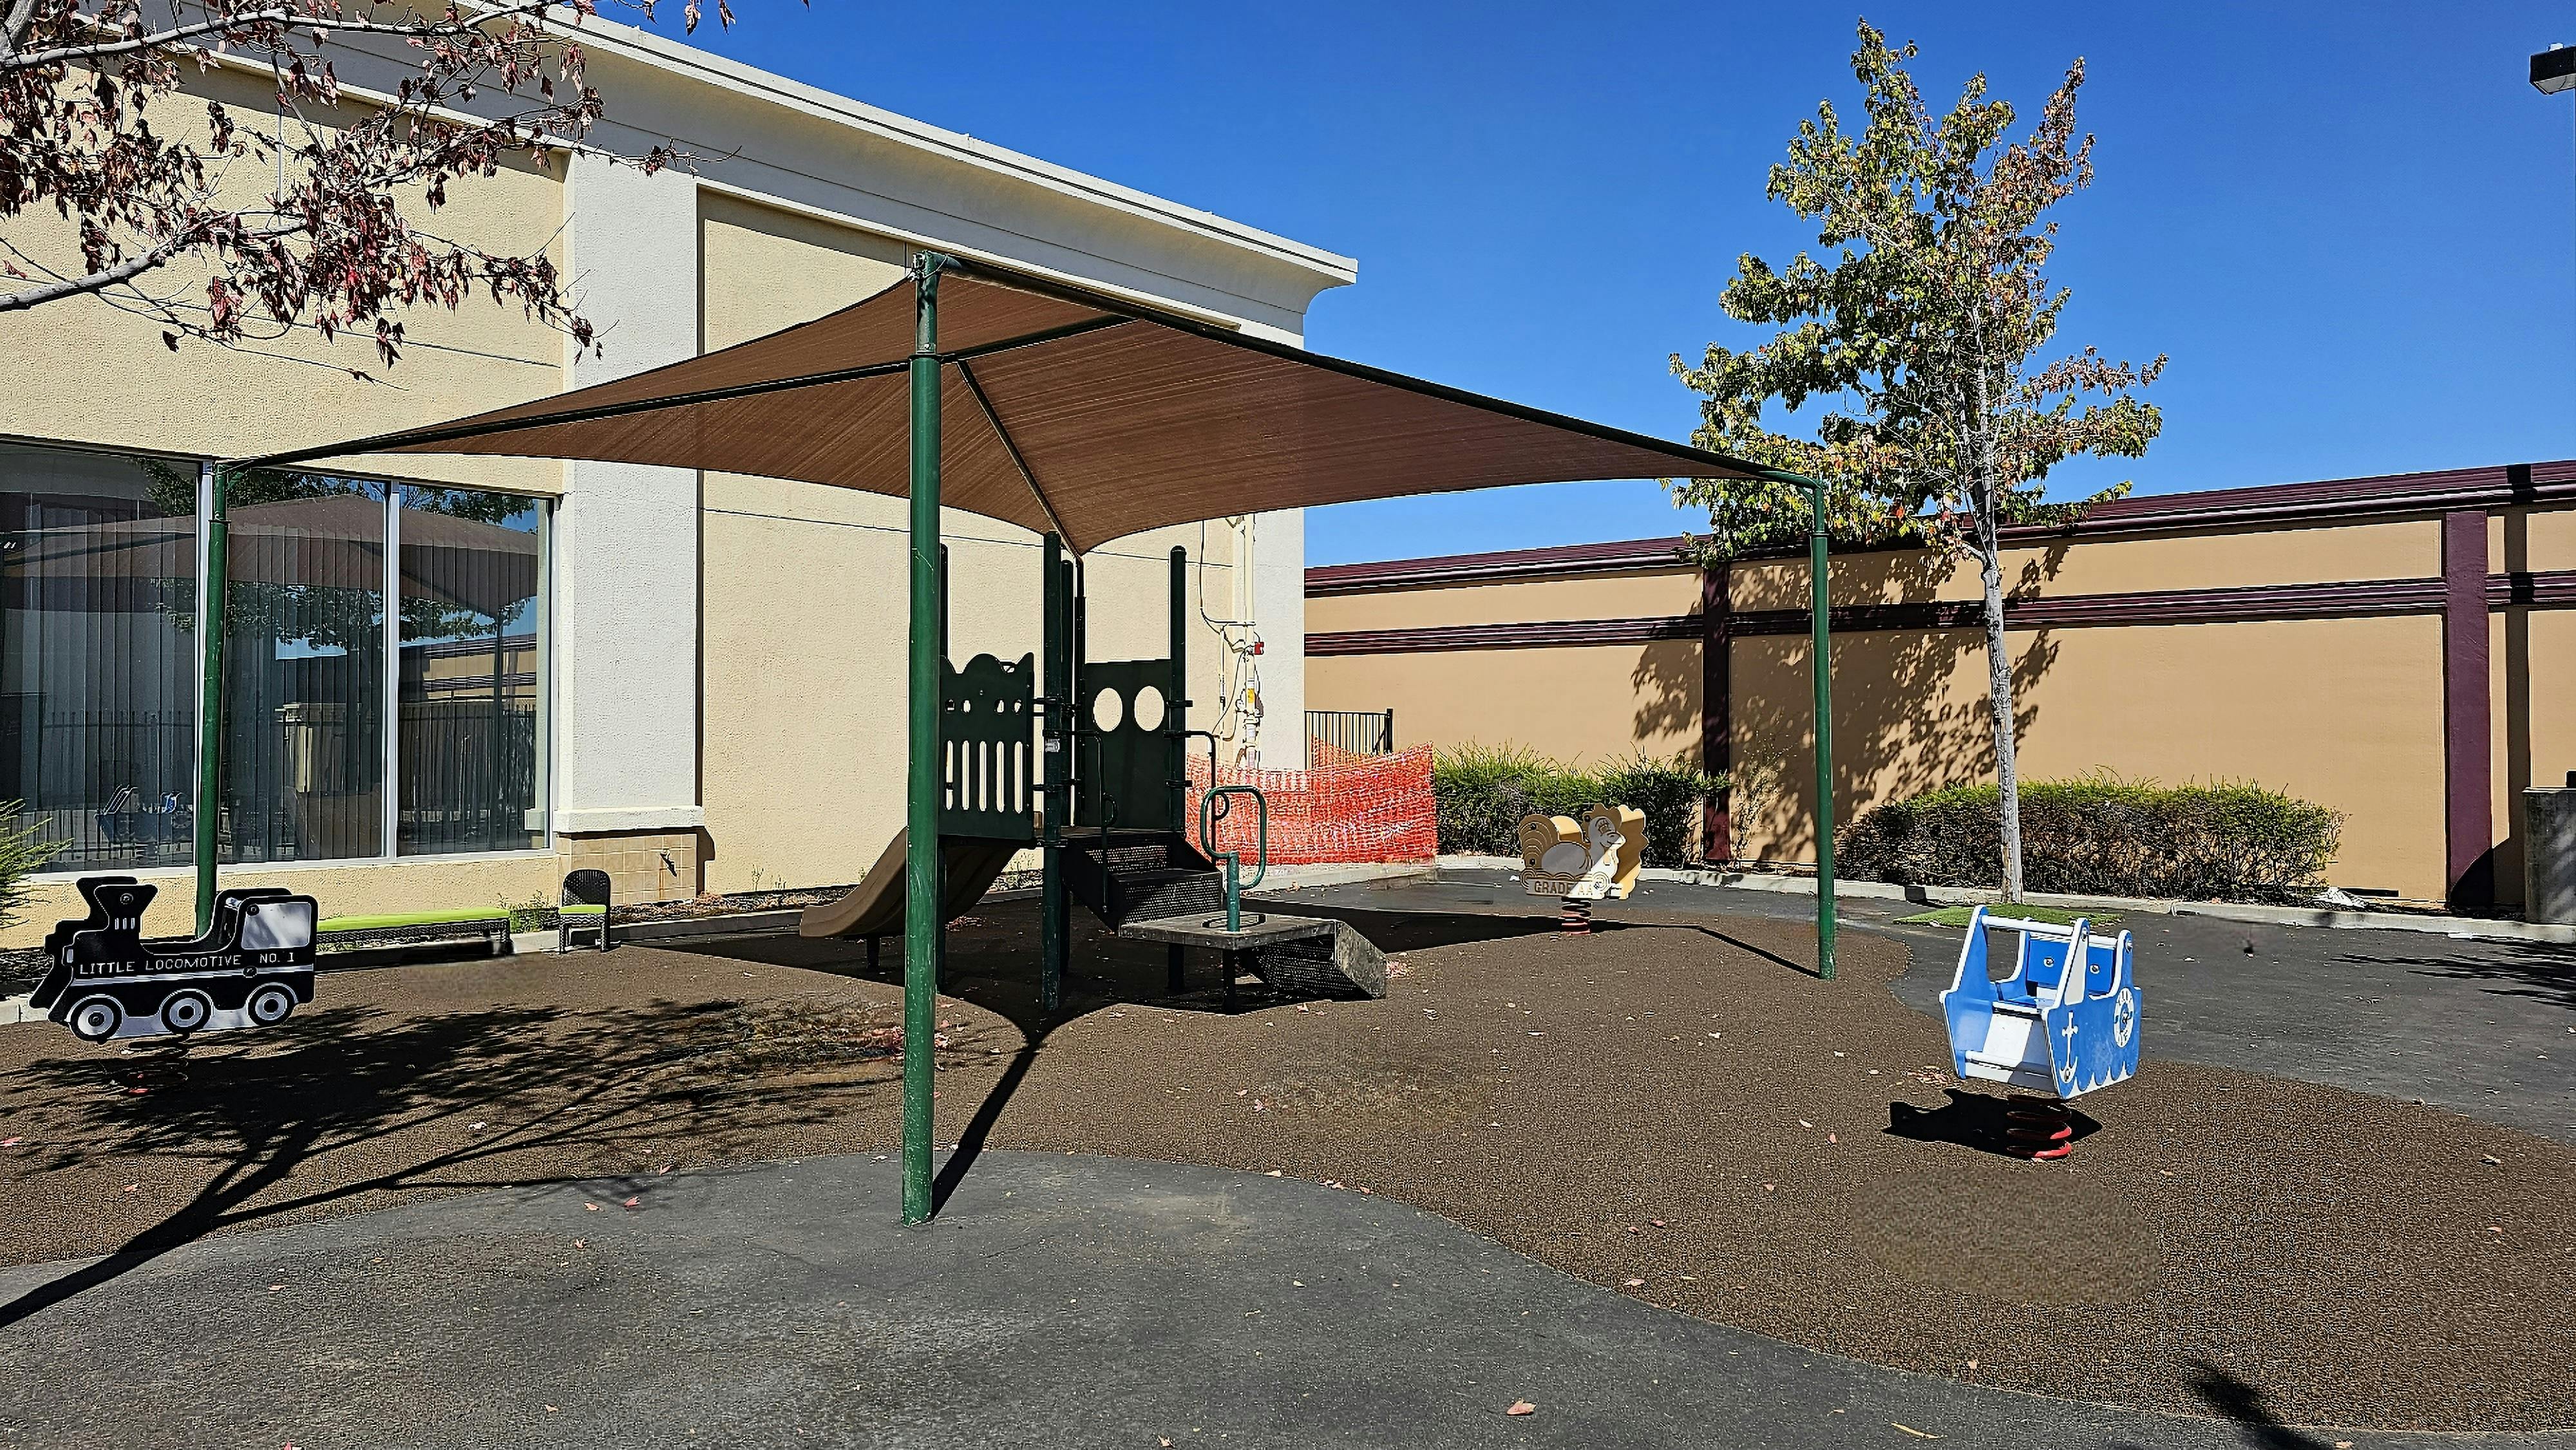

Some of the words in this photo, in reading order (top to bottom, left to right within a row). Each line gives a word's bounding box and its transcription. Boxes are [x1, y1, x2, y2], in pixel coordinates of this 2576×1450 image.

[1535, 881, 1573, 894] GRADE
[80, 961, 135, 974] LITTLE
[146, 955, 242, 970] LOCOMOTIVE
[260, 953, 280, 963] NO.
